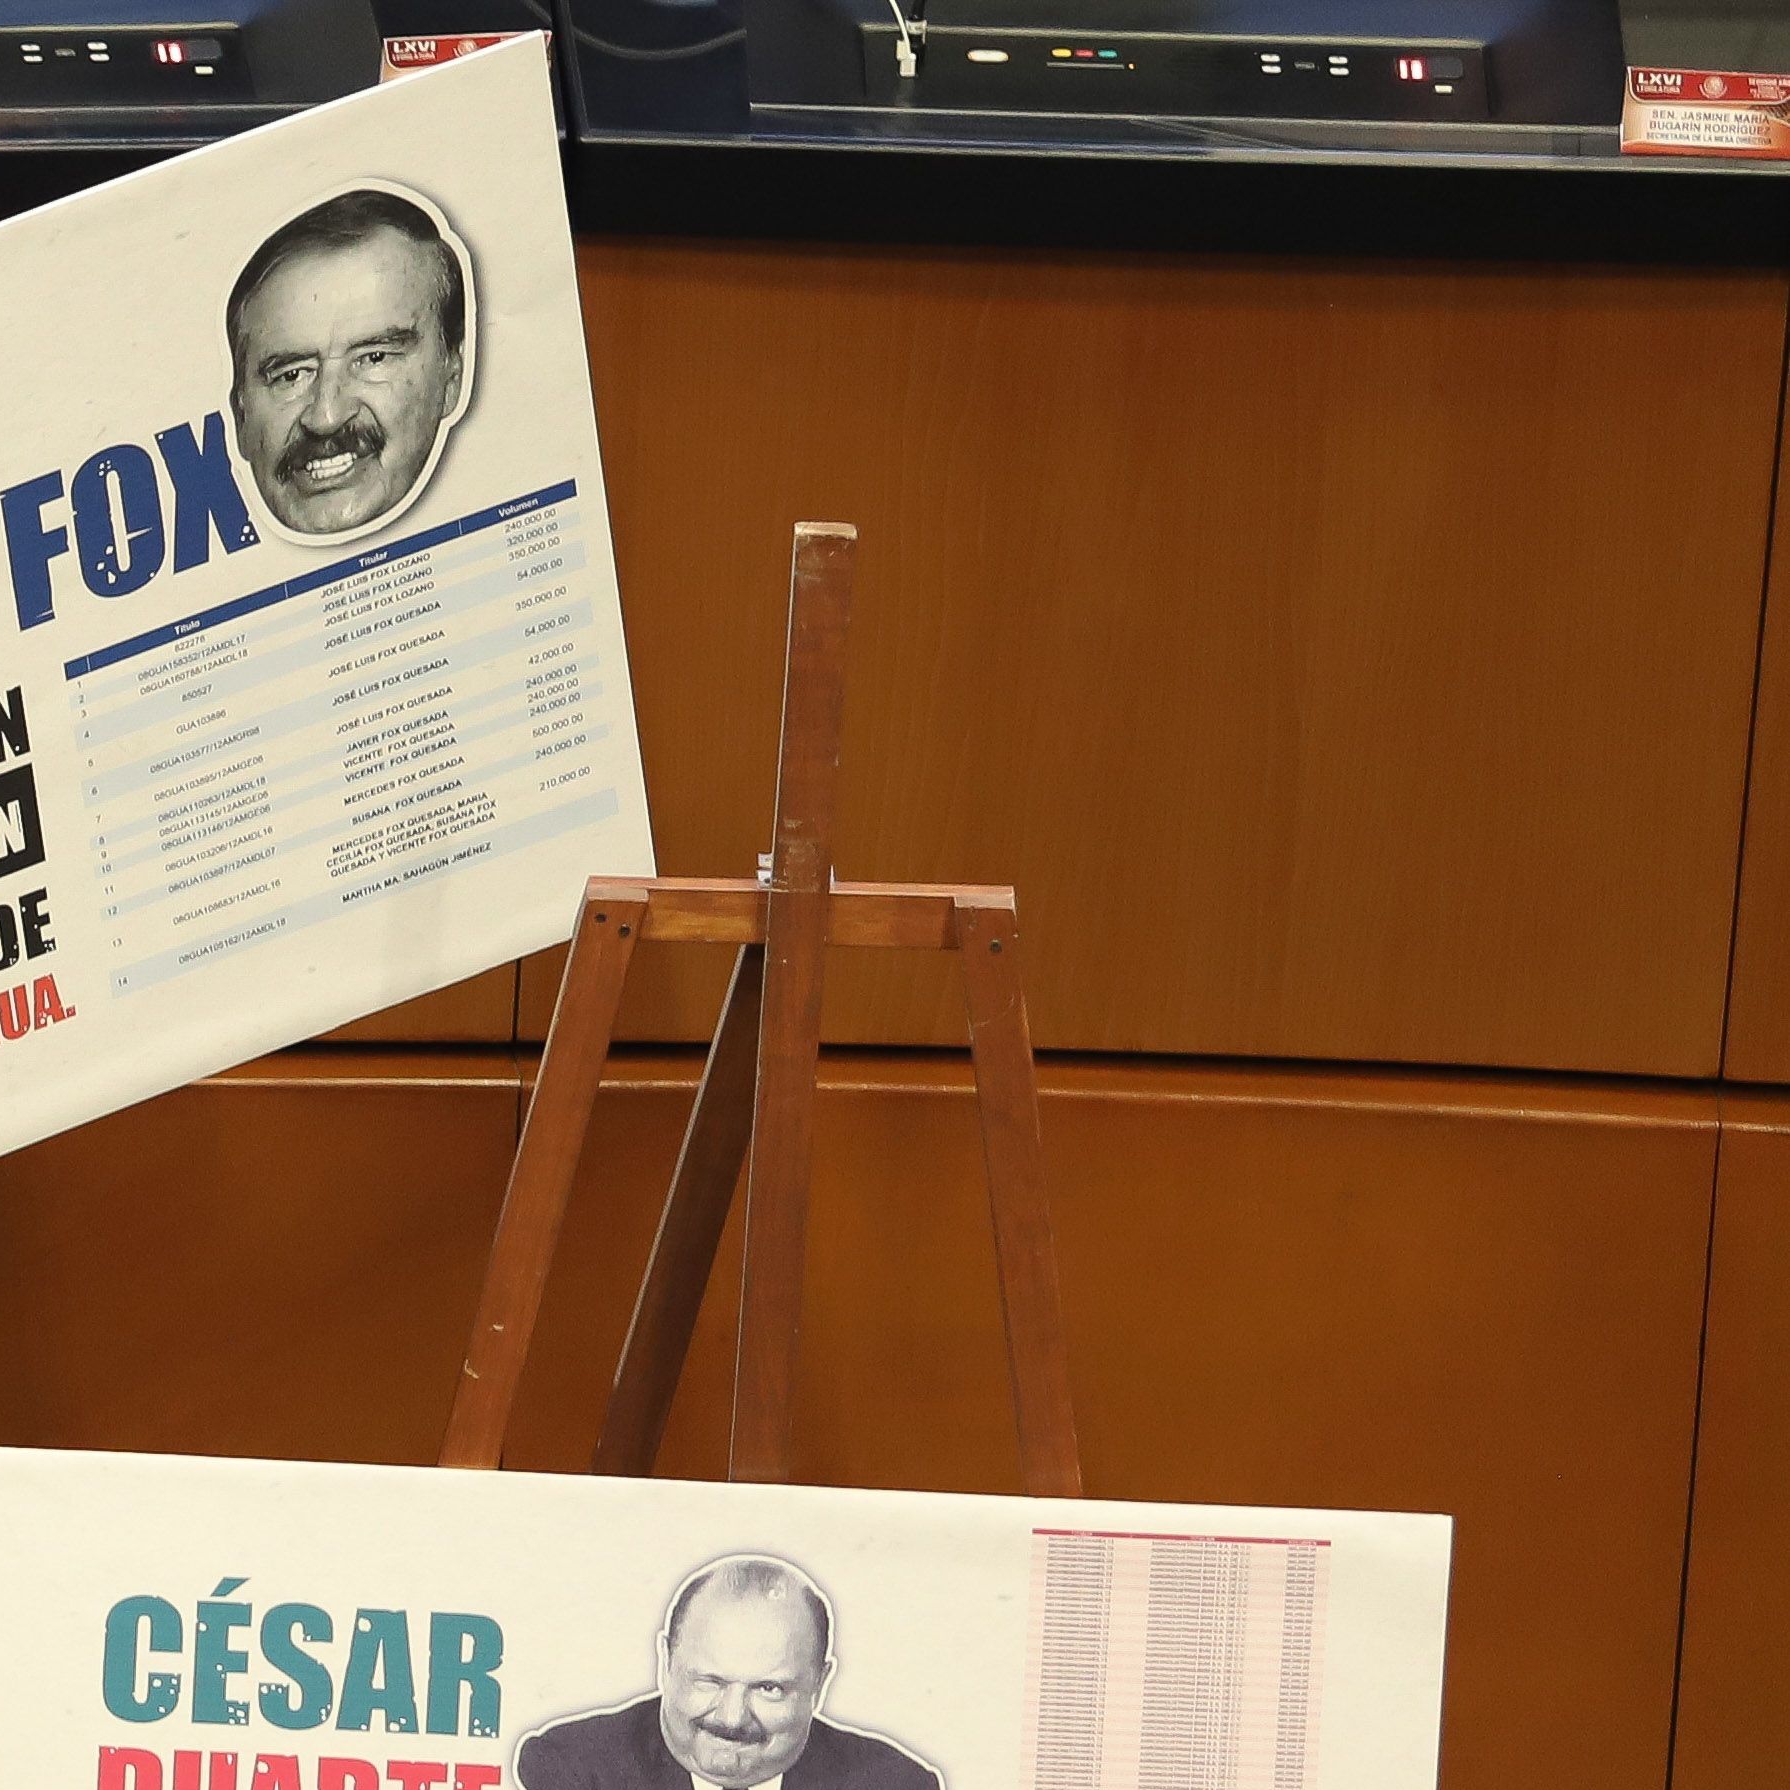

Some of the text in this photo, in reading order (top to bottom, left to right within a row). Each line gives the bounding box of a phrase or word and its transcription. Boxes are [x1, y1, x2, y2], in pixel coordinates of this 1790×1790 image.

[393, 41, 437, 53] LXVI
[1638, 73, 1682, 86] LXVI
[1681, 111, 1730, 122] JASMINE
[0, 411, 260, 631] FOX
[320, 552, 431, 599] JOSÉ LUIS FOX LOZANO
[323, 600, 442, 651] JOSÉ LUIS FOX QUESADA
[343, 756, 465, 807] MERCEDES FOX QUESADA
[102, 1576, 505, 1739] CÉSAR
